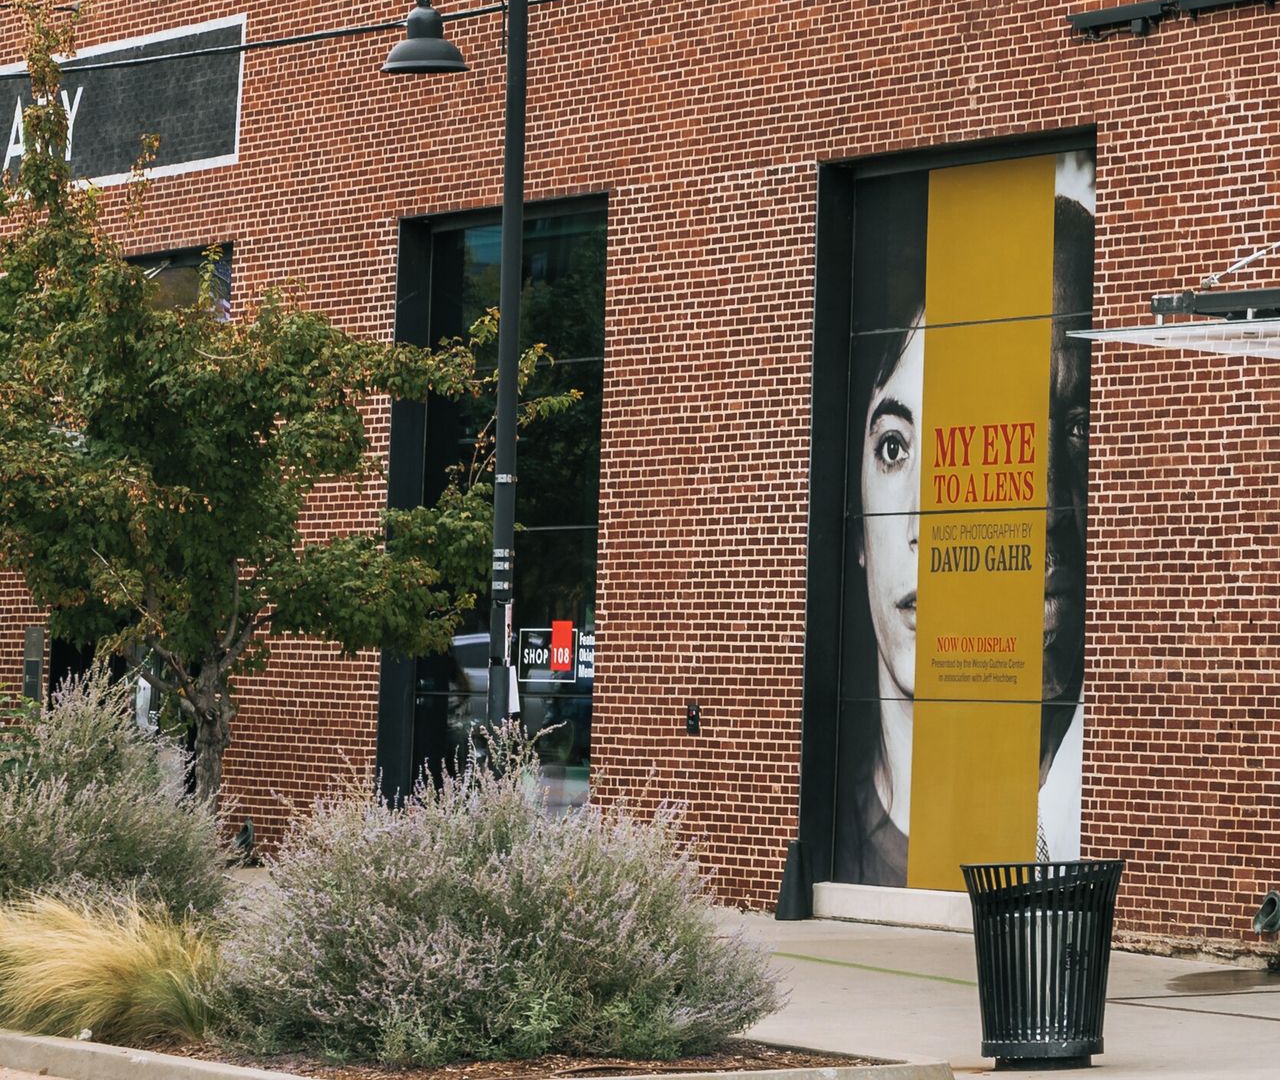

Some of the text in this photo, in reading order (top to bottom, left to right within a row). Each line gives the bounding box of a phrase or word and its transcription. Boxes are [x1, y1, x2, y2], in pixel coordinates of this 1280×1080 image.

[934, 422, 1035, 468] MY EYE
[933, 470, 1035, 504] TO A LENS
[932, 522, 1033, 541] MUSIC PHOTOGRAPHY BY
[930, 543, 1032, 572] DAVID GAHR
[523, 647, 570, 664] SHOP 108
[936, 635, 1016, 653] NOW ON DISPLAY
